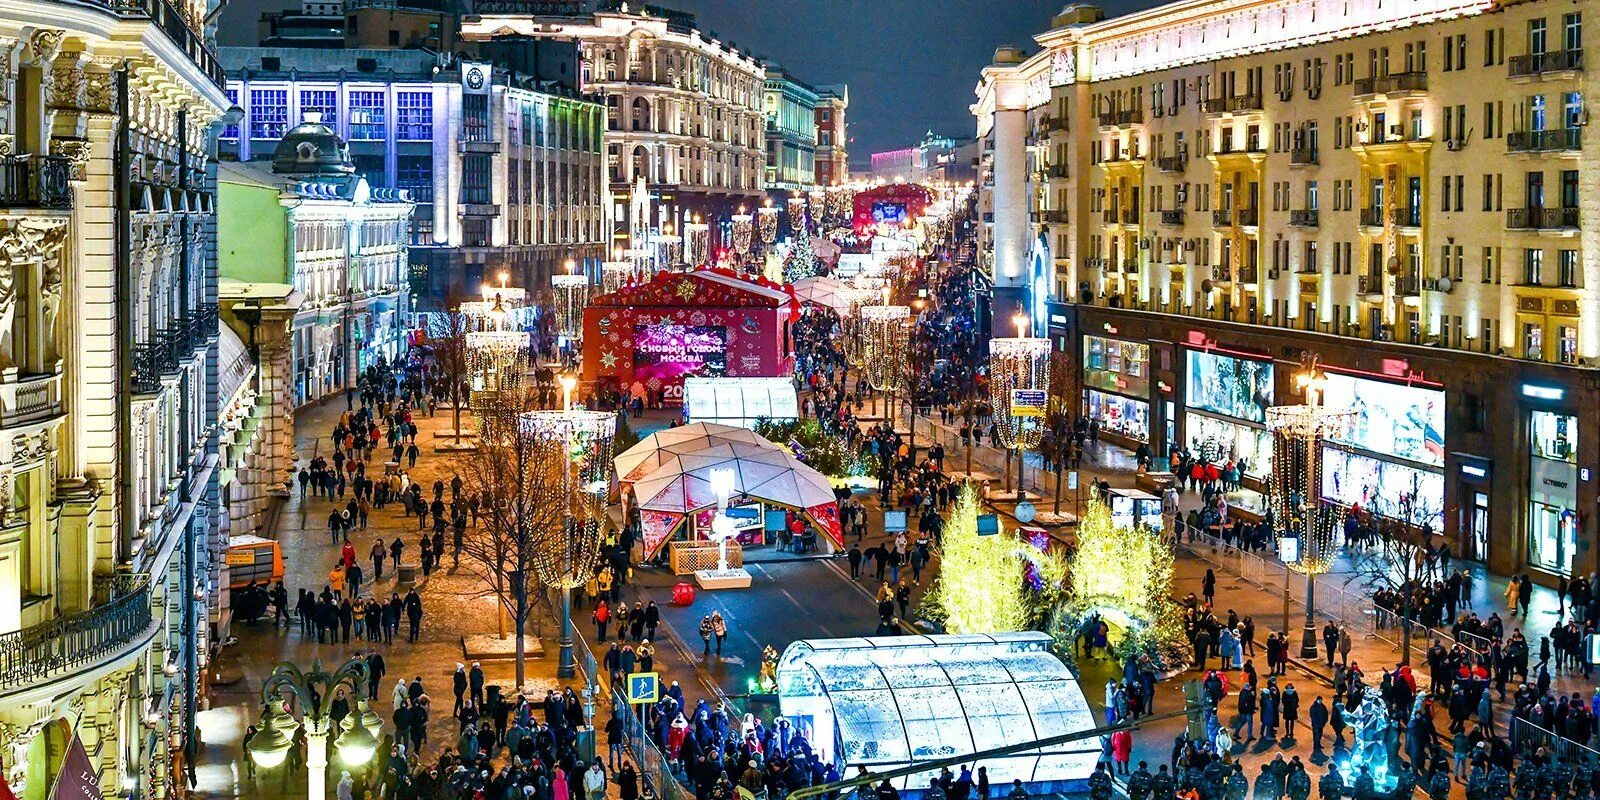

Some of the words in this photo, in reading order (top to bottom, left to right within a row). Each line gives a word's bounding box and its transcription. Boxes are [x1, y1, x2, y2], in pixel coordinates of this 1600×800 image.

[640, 345, 647, 353] С
[661, 354, 703, 363] МОСКВА!
[663, 384, 684, 398] 20
[80, 770, 98, 787] LU
